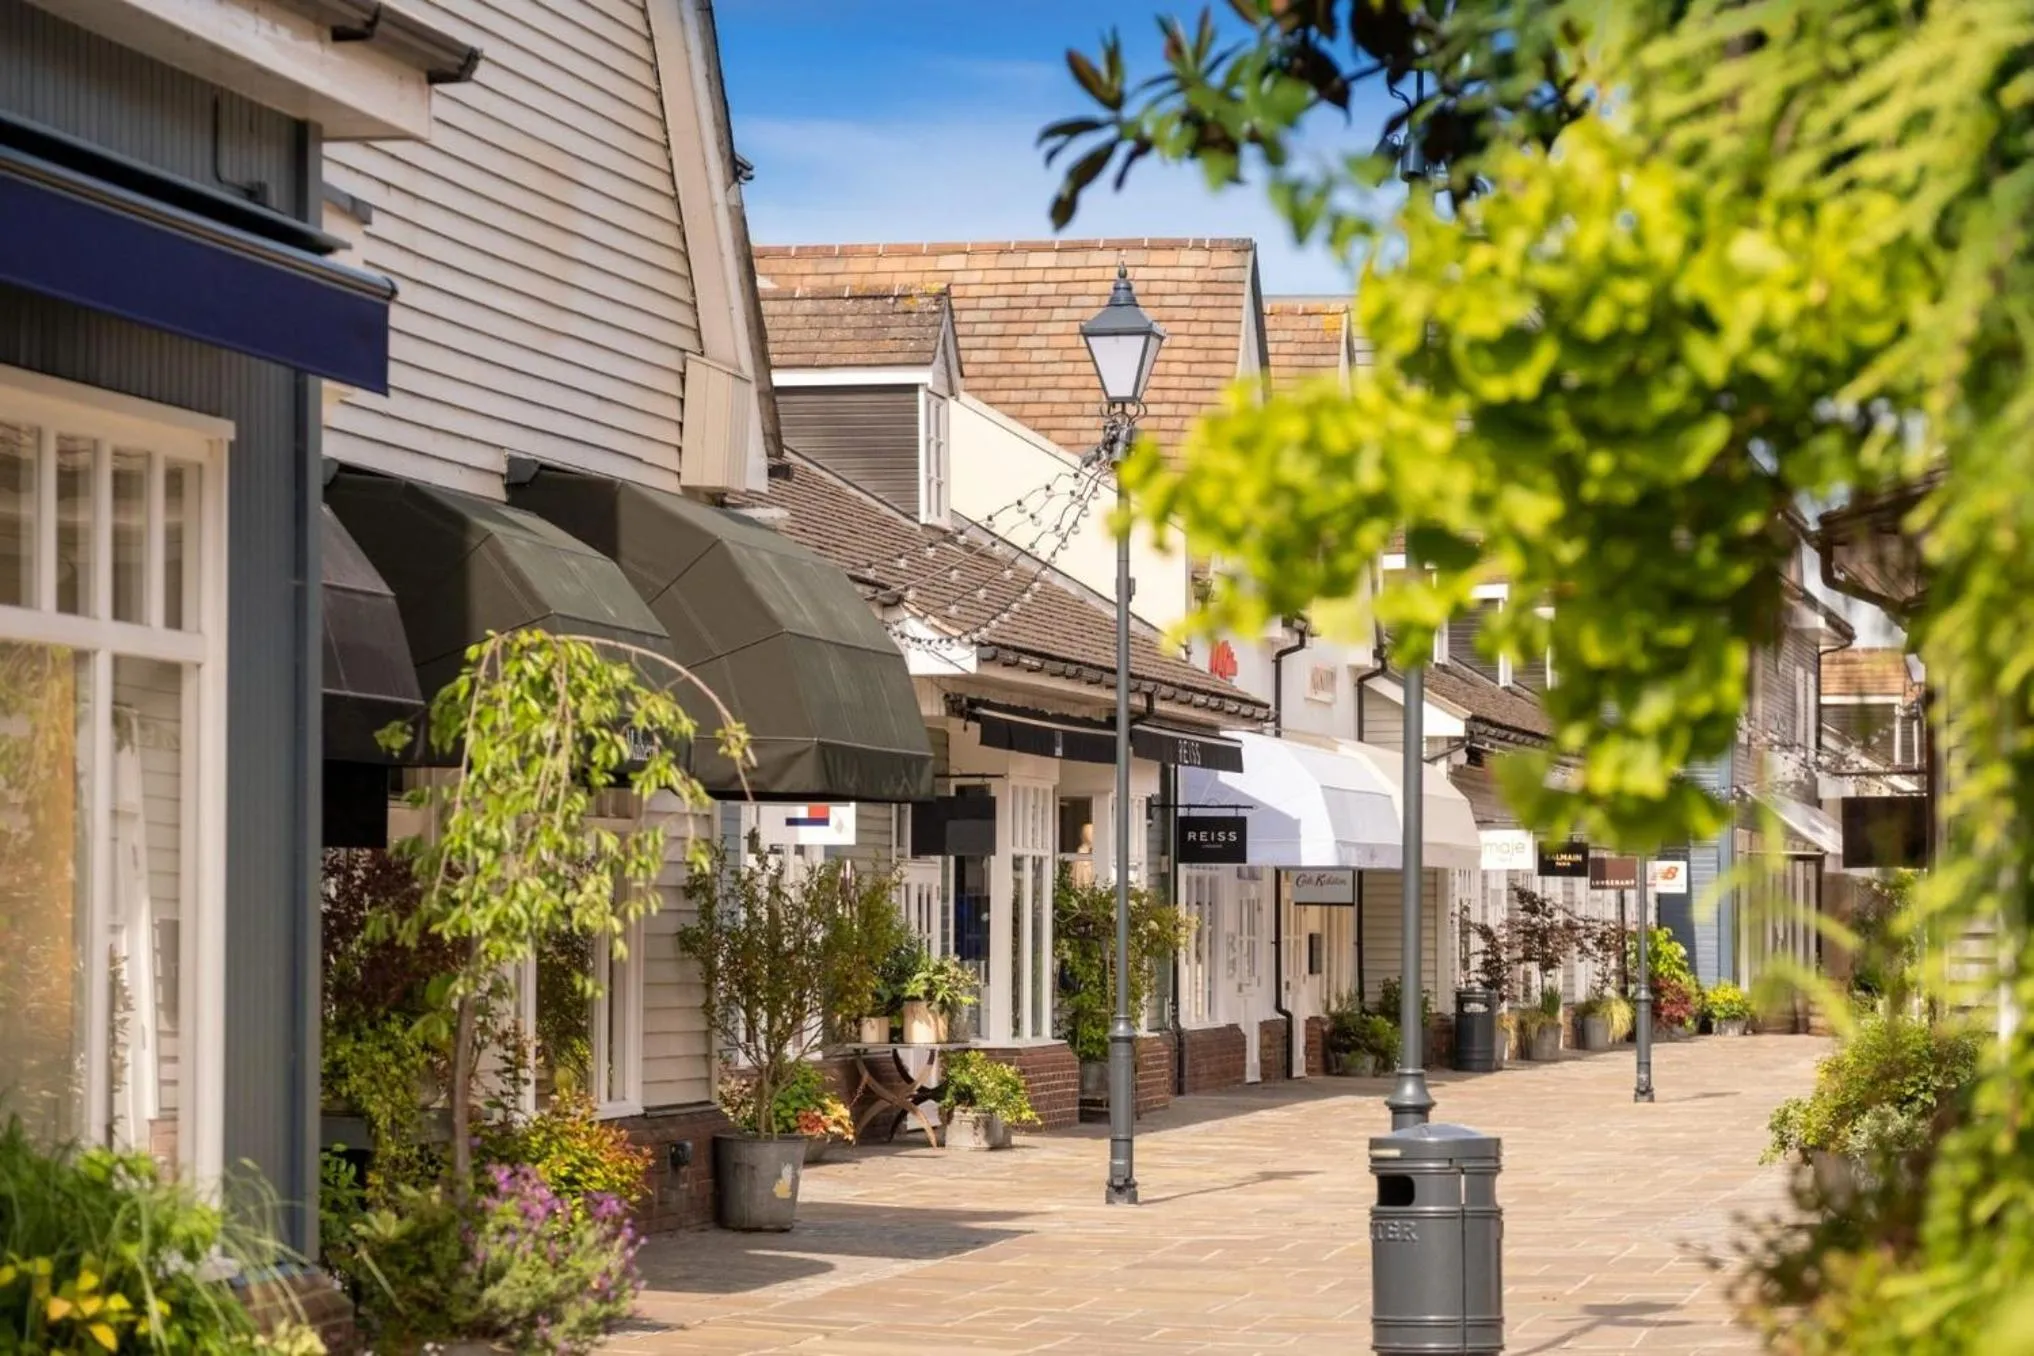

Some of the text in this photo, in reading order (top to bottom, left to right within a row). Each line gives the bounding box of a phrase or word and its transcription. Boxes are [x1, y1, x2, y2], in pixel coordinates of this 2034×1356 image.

[1179, 739, 1201, 766] REISS
[1187, 831, 1238, 842] REISS
[1484, 838, 1525, 860] maje
